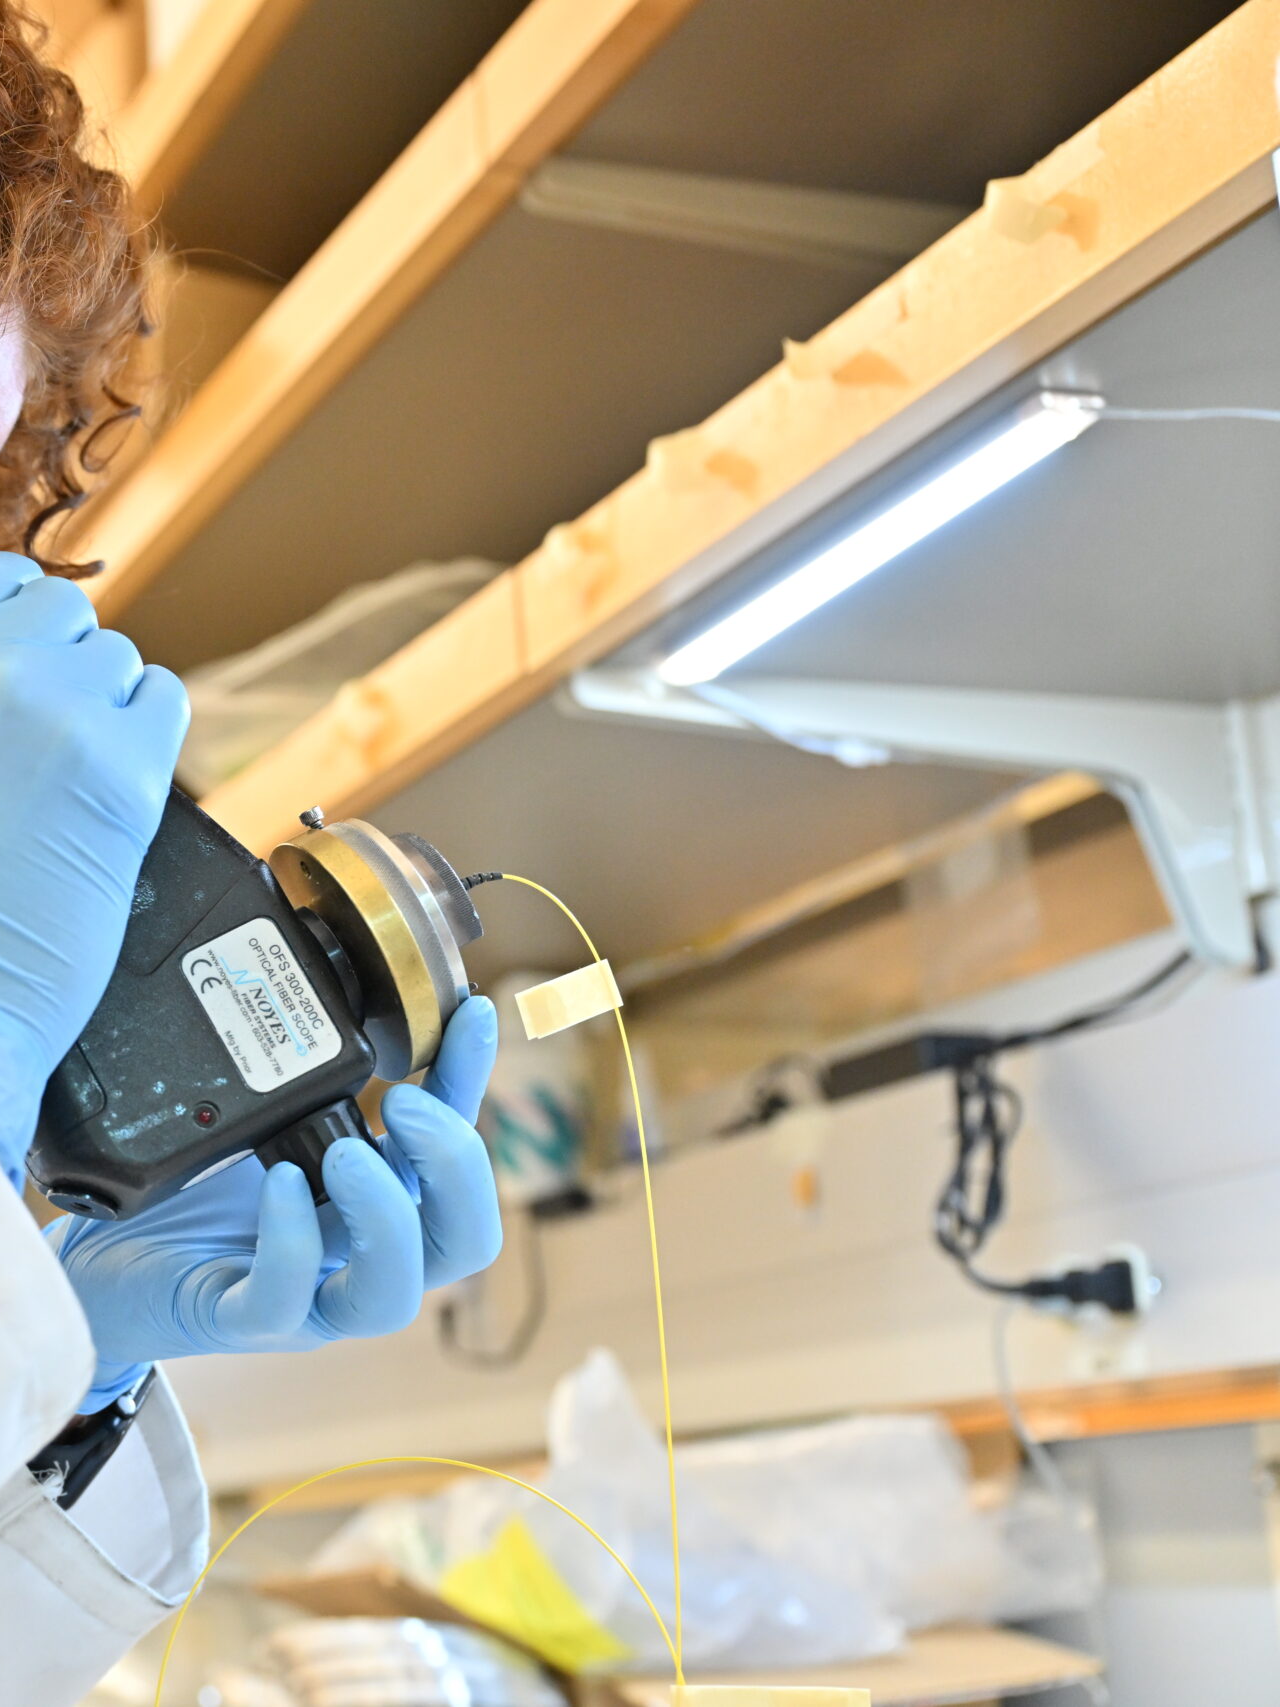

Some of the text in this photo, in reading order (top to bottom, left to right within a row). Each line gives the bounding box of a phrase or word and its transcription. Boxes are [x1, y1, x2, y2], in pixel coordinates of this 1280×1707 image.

[208, 949, 252, 1023] www.noyes-fiber.com
[248, 938, 318, 1050] OPTICAL FIBER SCOPE
[249, 986, 291, 1044] NOYES
[269, 944, 324, 1030] OFS 300-200C
[224, 1030, 252, 1073] Mfg by Prior
[241, 993, 276, 1048] FIBER SYSTEMS
